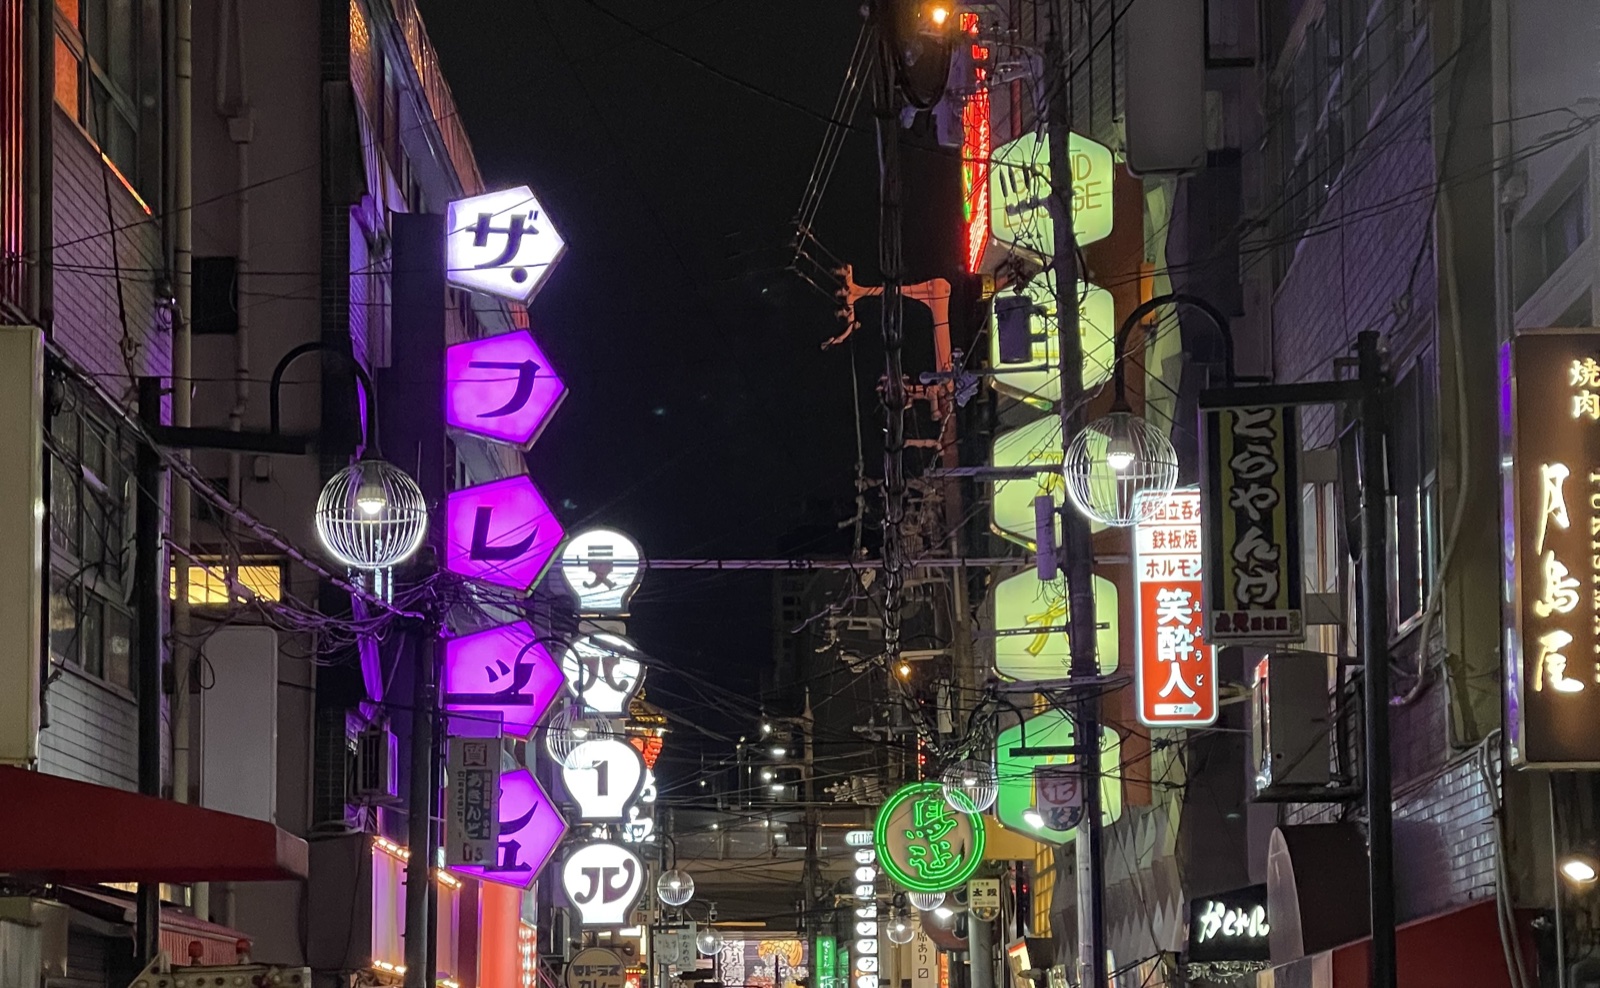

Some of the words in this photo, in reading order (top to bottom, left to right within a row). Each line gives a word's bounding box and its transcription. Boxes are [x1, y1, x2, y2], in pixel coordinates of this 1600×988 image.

[1570, 357, 1600, 419] 焼肉
[1152, 530, 1198, 549] 鉄板焼
[1146, 559, 1202, 579] ホルモン
[1156, 588, 1195, 698] 笑酔人
[573, 965, 621, 977] マドラス
